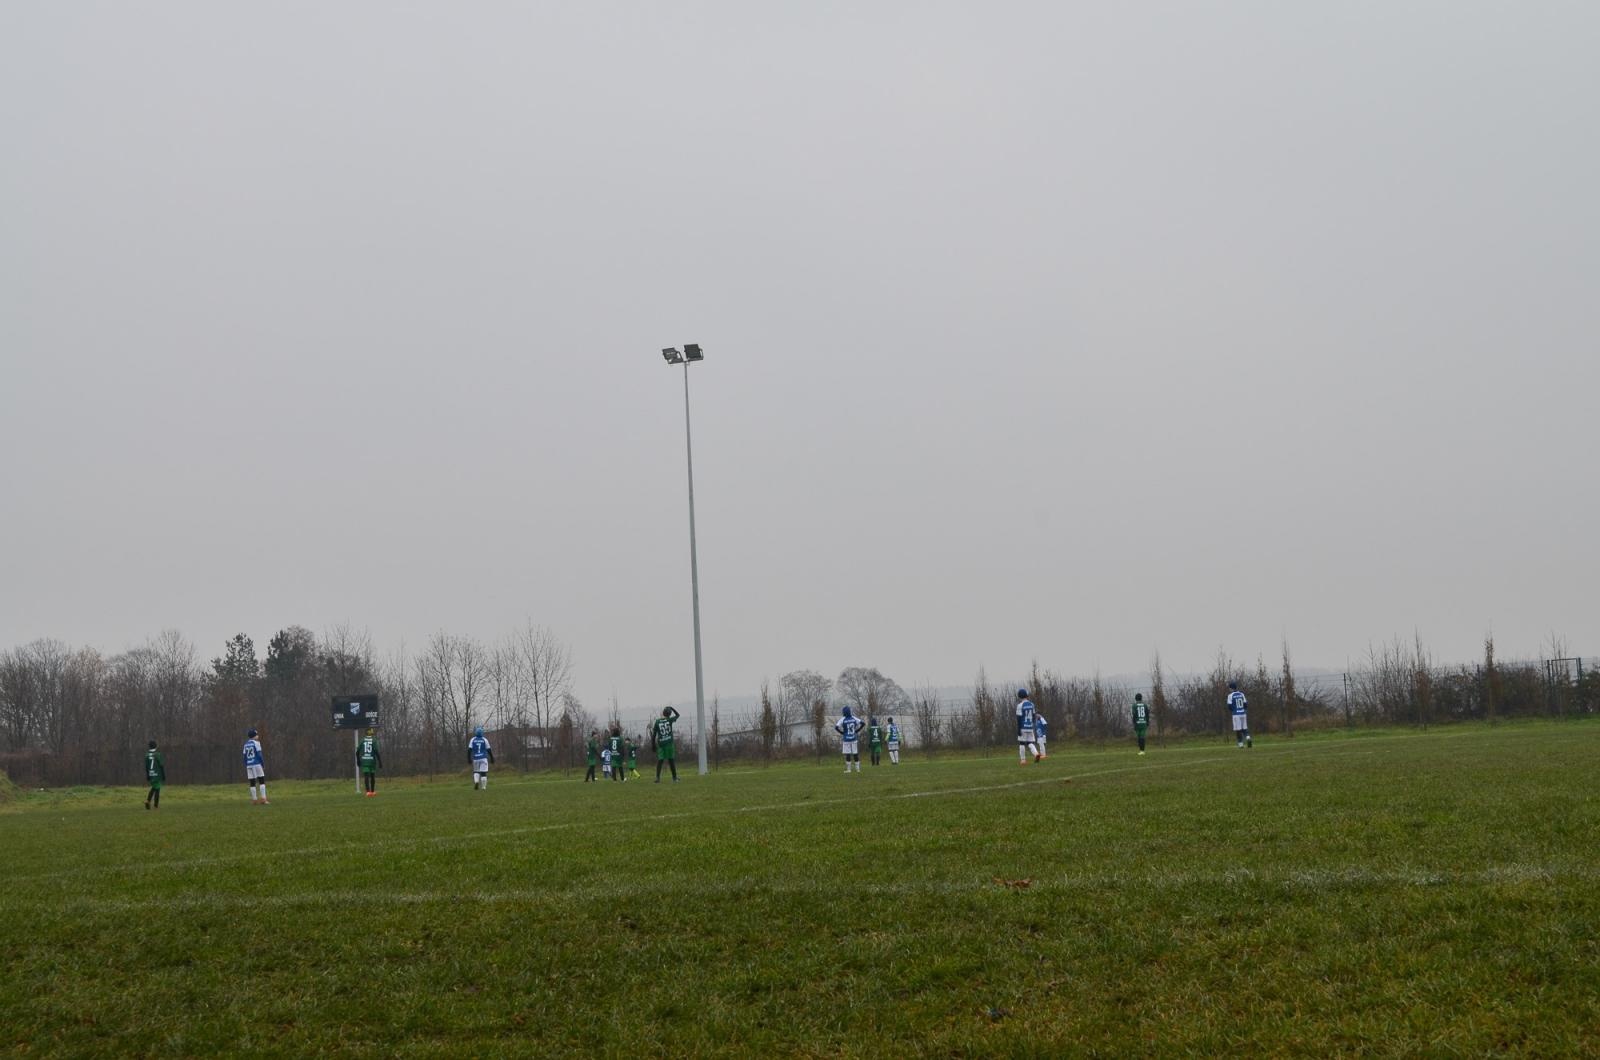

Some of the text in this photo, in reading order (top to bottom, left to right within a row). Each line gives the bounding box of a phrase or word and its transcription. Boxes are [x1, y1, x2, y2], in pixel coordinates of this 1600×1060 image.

[1235, 698, 1244, 709] 10
[1137, 706, 1146, 718] 18
[658, 721, 671, 736] 55
[873, 728, 879, 738] 4
[363, 741, 373, 753] 15
[476, 742, 482, 754] 7
[612, 740, 617, 750] 8
[149, 756, 154, 770] 7
